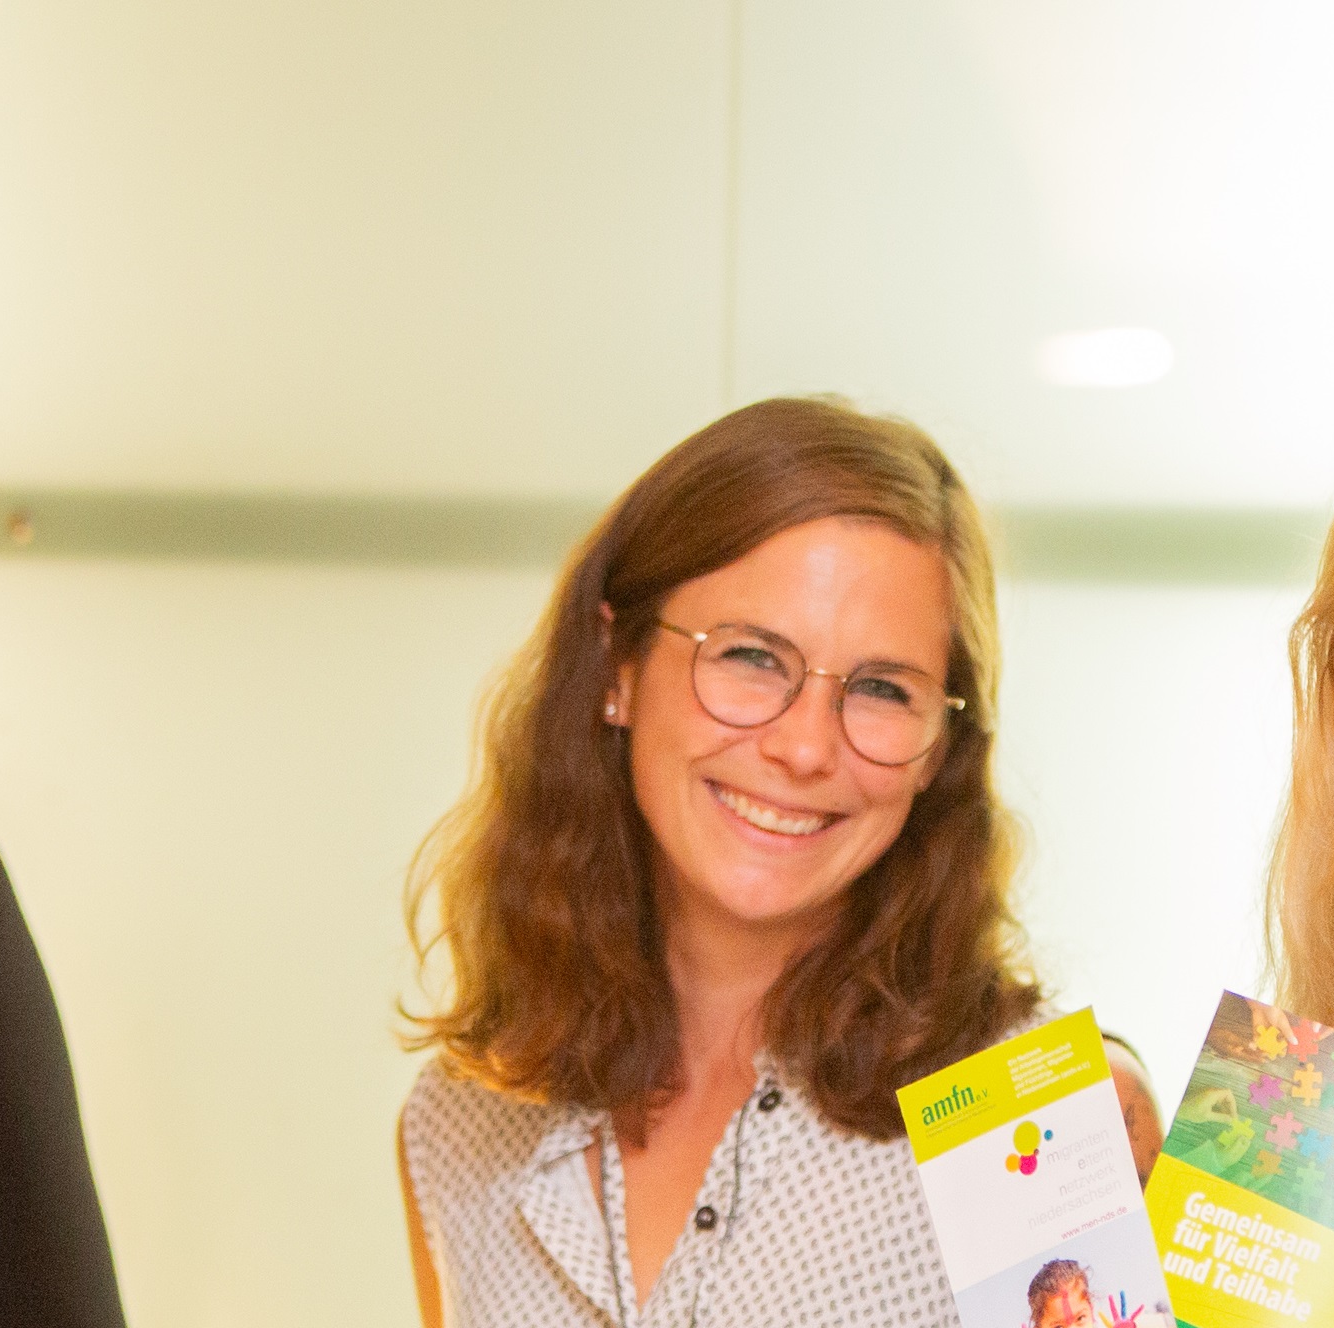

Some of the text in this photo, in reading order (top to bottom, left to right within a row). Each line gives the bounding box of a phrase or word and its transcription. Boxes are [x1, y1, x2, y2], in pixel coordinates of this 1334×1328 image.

[921, 1084, 975, 1126] amfn
[1047, 1129, 1109, 1164] migranten
[1078, 1146, 1113, 1170] eltern
[1059, 1163, 1117, 1197] netzwerk
[1028, 1180, 1122, 1230] niedersachsen
[1185, 1192, 1321, 1262] Gemeinsam
[1173, 1218, 1300, 1286] für Vielfalt
[1163, 1251, 1311, 1322] und Teilhabe
